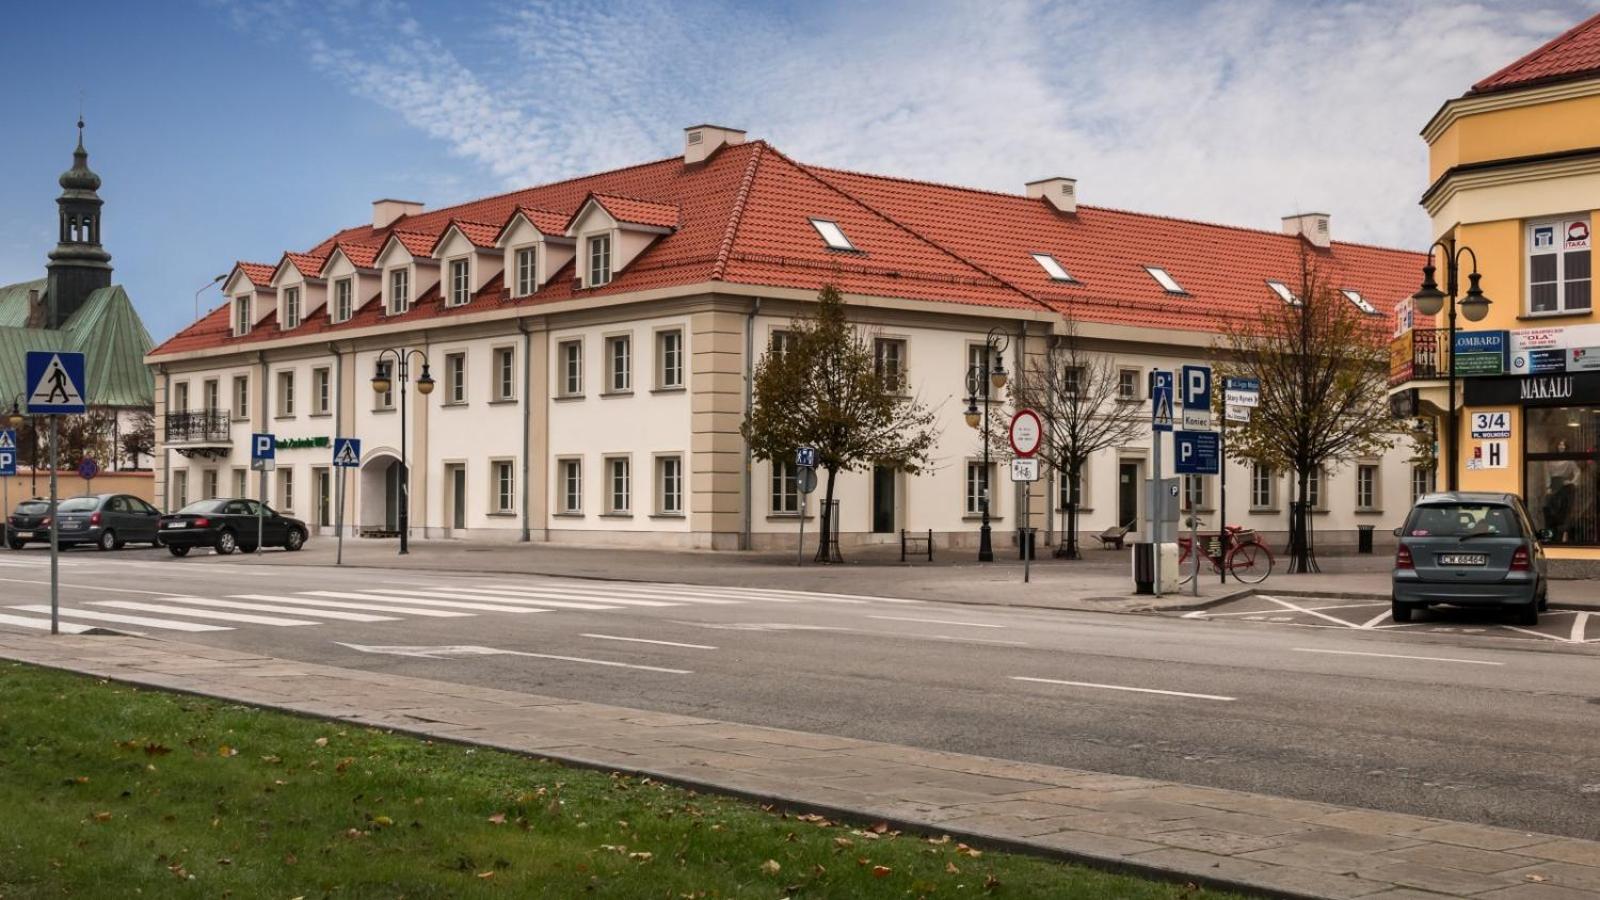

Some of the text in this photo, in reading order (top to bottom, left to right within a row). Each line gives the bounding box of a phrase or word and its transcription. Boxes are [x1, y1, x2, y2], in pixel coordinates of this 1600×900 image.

[1565, 241, 1587, 249] ITAKA
[1455, 336, 1501, 347] OMBARD
[1157, 376, 1165, 388] P
[1189, 369, 1206, 404] P
[1520, 376, 1574, 400] MAKALU
[1185, 416, 1208, 427] Koniec
[1477, 413, 1506, 429] 3/4
[257, 436, 271, 456] P
[1181, 442, 1192, 462] P
[1489, 442, 1501, 466] H
[0, 452, 12, 469] P
[1172, 486, 1178, 496] P
